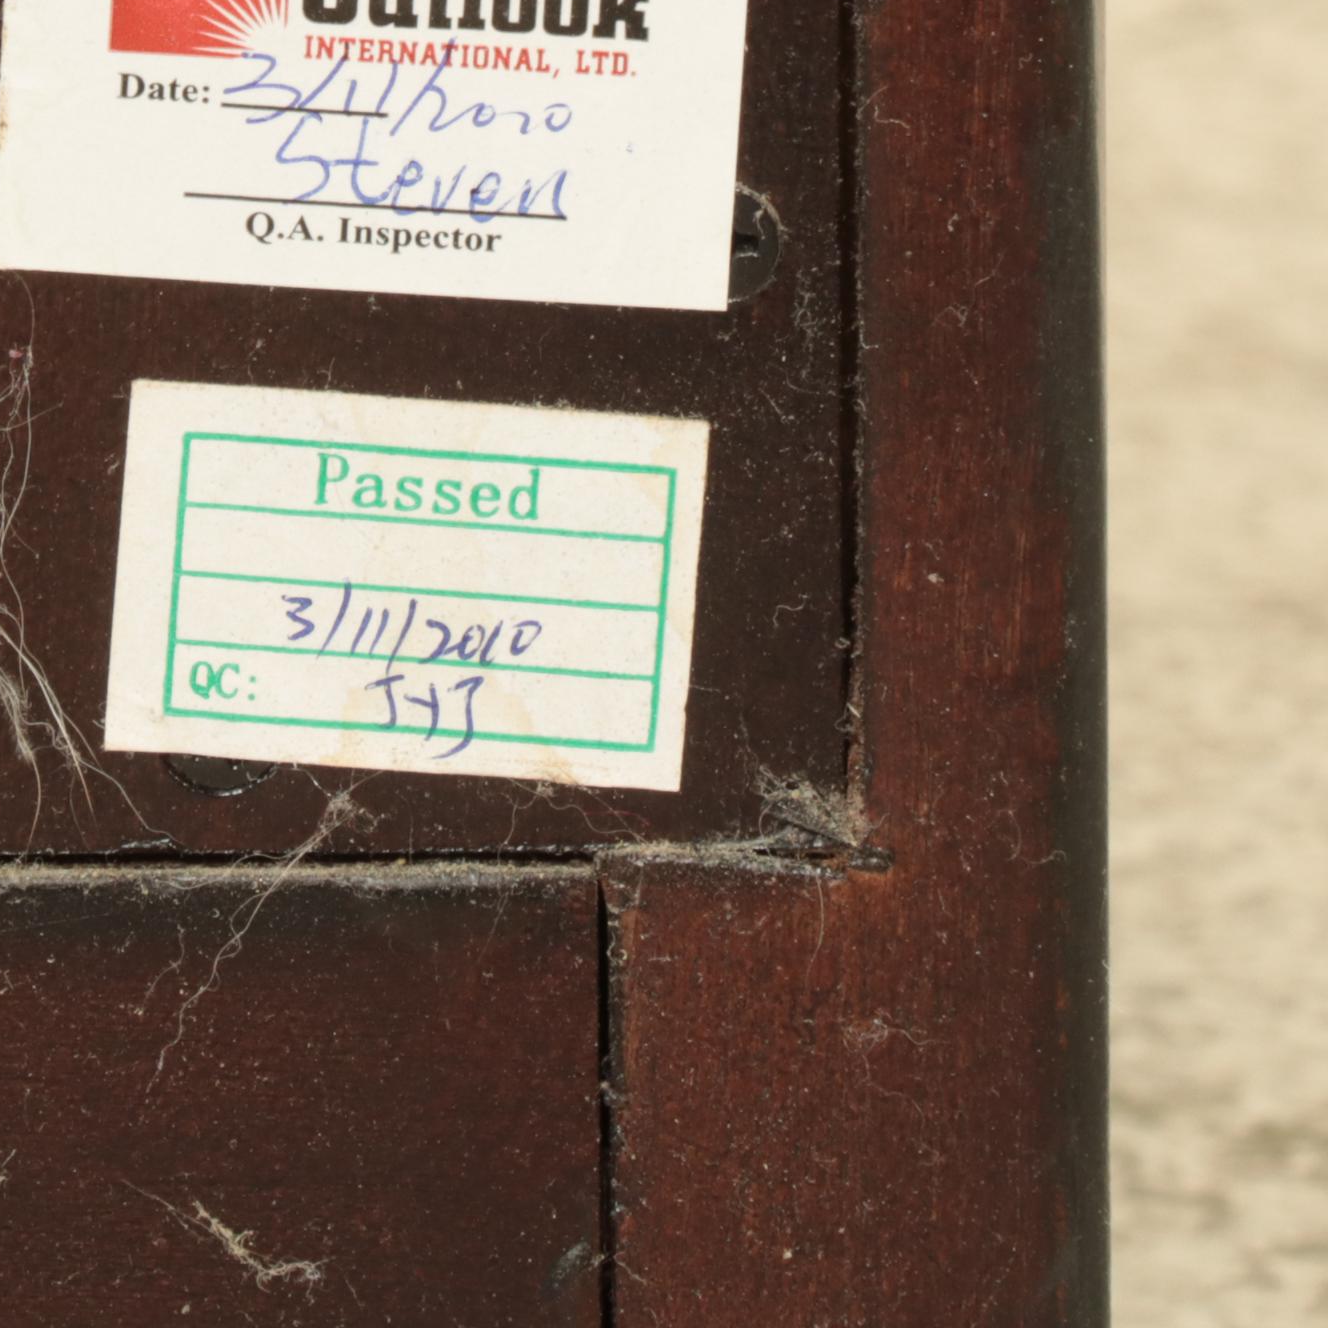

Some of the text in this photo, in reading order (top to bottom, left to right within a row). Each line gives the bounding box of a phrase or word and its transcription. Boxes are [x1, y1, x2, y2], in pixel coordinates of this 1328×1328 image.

[304, 35, 637, 78] INTERNATIONAL, LTD.
[118, 73, 210, 104] Date:
[274, 115, 568, 223] Steven
[245, 211, 503, 254] Q.A. Inspector
[314, 452, 541, 520] Passed
[281, 578, 543, 674] 3/11/2010
[189, 661, 257, 701] QC:
